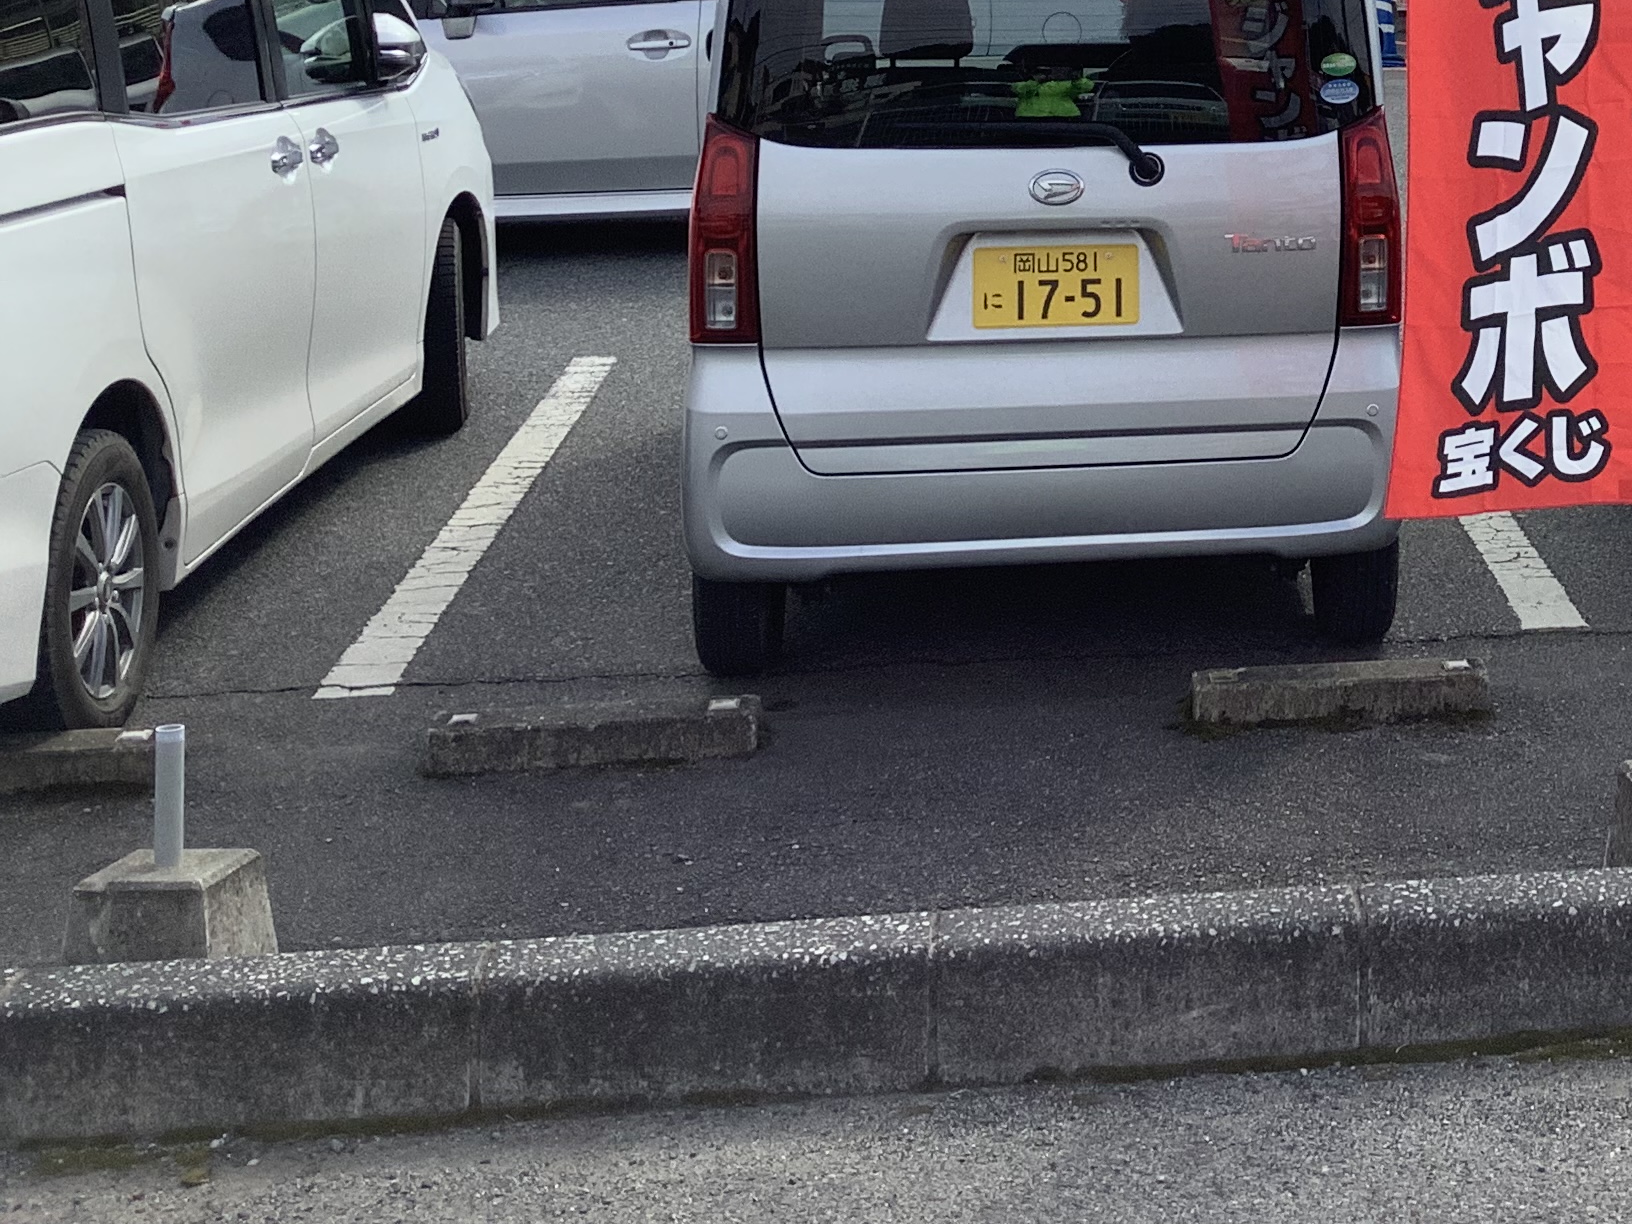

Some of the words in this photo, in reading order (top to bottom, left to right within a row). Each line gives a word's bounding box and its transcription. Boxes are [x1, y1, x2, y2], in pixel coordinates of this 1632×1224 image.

[982, 292, 1003, 311] に
[1016, 277, 1124, 321] 17-51
[1437, 415, 1606, 494] 宝くじ
